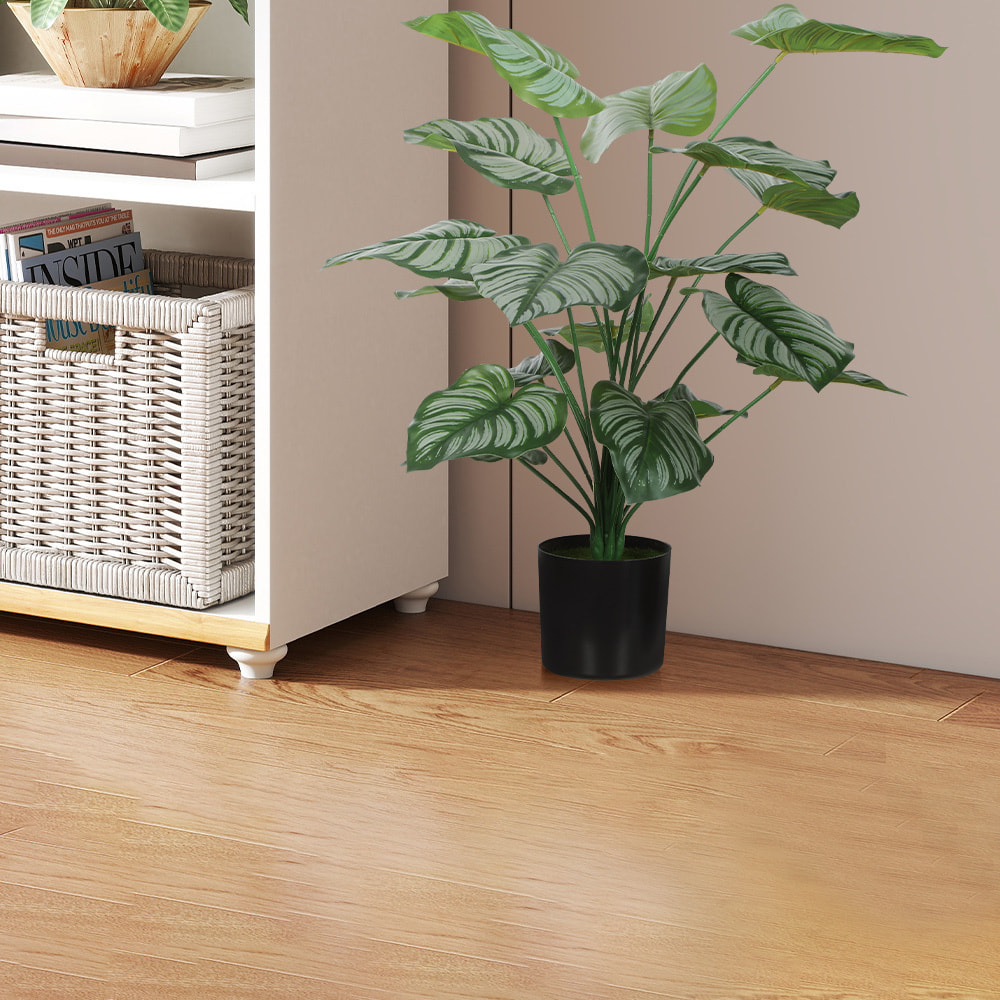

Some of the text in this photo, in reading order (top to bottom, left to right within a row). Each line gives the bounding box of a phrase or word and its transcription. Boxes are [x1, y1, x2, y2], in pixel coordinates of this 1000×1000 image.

[48, 227, 56, 236] THE
[56, 225, 65, 234] ONLY
[66, 222, 75, 232] MAG
[67, 237, 82, 248] WPT
[26, 241, 137, 287] INSIDE
